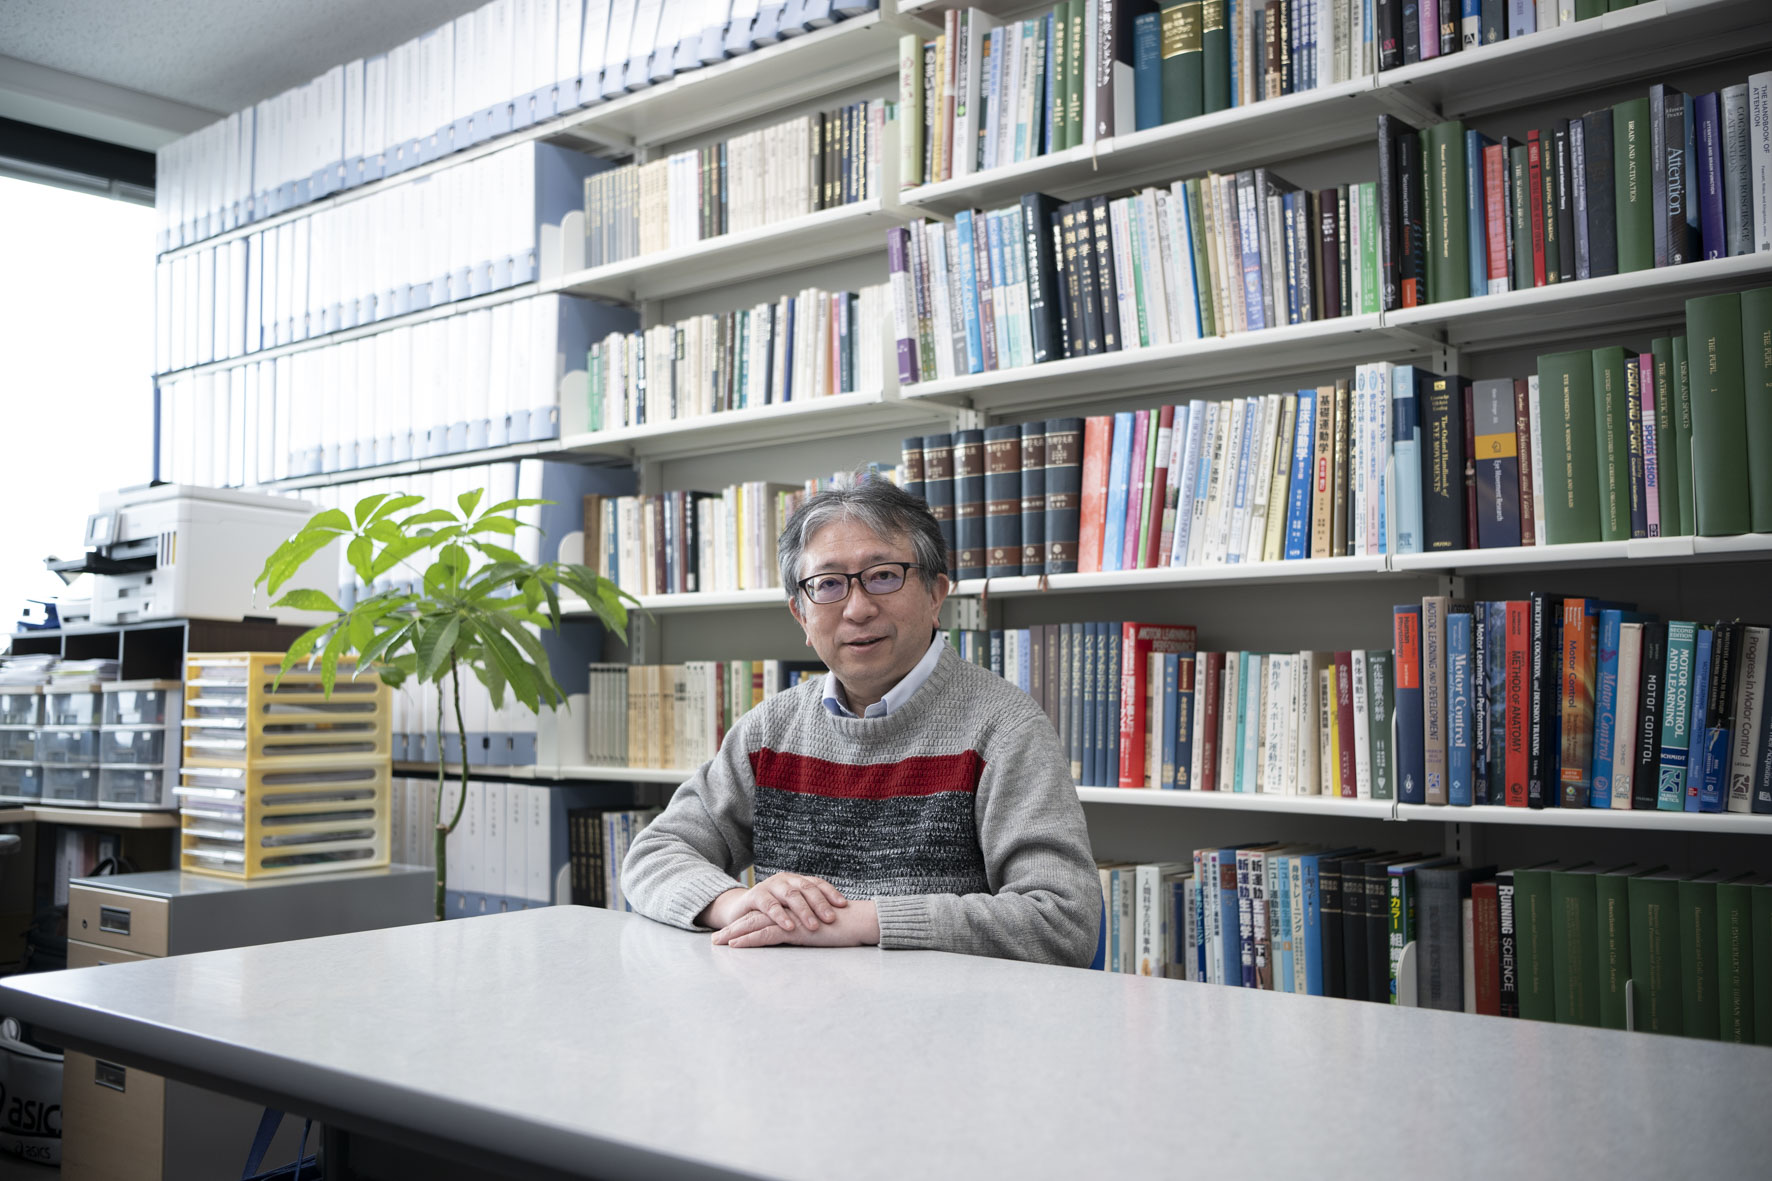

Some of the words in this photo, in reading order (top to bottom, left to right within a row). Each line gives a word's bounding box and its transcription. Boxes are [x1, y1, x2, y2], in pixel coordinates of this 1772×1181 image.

[1753, 87, 1761, 127] ATTENTION
[1761, 101, 1769, 142] HANDBOOK
[1728, 119, 1738, 174] ATTENTION
[1737, 107, 1747, 160] COGNITIVE
[1763, 144, 1770, 153] OF
[1668, 147, 1684, 216] Attention
[1740, 166, 1750, 241] NEUROSCIENCE
[1708, 337, 1716, 353] THE
[1763, 330, 1771, 346] THE
[1626, 362, 1639, 393] VISION
[1680, 361, 1688, 383] VISION
[1709, 354, 1717, 375] PUPIL
[1628, 394, 1640, 420] AND
[1660, 379, 1668, 412] ATHLETIC
[1681, 386, 1689, 400] AND
[1318, 395, 1330, 454] 基礎運動学
[1433, 422, 1441, 438] EYE
[1441, 416, 1449, 429] The
[1517, 417, 1527, 430] Eye
[1629, 421, 1642, 457] SPORT
[1645, 425, 1657, 455] SPORTS
[1441, 430, 1449, 452] Oxford
[1520, 433, 1529, 473] Movements
[1433, 440, 1441, 492] MOVEMENTS
[1493, 460, 1501, 469] Eye
[1647, 457, 1655, 487] VISION
[1441, 489, 1449, 498] of
[1495, 470, 1503, 498] Movement
[1522, 476, 1530, 491] and
[1428, 602, 1437, 629] MOTOR
[1428, 631, 1437, 669] LEARNING
[1476, 624, 1485, 649] Motor
[1454, 654, 1467, 692] Motor
[1476, 650, 1484, 685] Learning
[1511, 650, 1521, 692] METHOD
[1533, 641, 1541, 680] COGNITION,
[1569, 640, 1577, 670] Motor
[1669, 648, 1678, 671] AND
[1677, 649, 1690, 687] MOTOR
[1746, 637, 1759, 678] Progress
[1271, 660, 1281, 691] 動作学
[1354, 657, 1364, 714] 身体運動工学
[1568, 673, 1576, 708] Control
[1602, 672, 1615, 707] Motor
[1429, 686, 1438, 741] DEVELOPMENT
[1512, 694, 1520, 704] OF
[1533, 692, 1541, 723] DECISION
[1665, 673, 1678, 727] LEARNING
[1674, 688, 1688, 738] CONTROL
[1743, 692, 1754, 720] Motor
[1268, 702, 1280, 772] スポーツ運動学
[1455, 696, 1467, 747] Control
[1477, 698, 1485, 749] Performance
[1512, 706, 1521, 753] ANATOMY
[1599, 712, 1613, 761] Control
[1532, 724, 1540, 756] TRAINING
[1740, 723, 1751, 757] Control
[1763, 749, 1772, 786] Acquisition
[1238, 859, 1252, 940] 新運動生理学
[1251, 860, 1266, 941] 新運動生理学
[1269, 862, 1281, 938] ニュー運動生理学
[1292, 865, 1302, 933] 身体トレーニング
[1498, 885, 1514, 934] RUNNING
[1502, 937, 1514, 992] SCIENCE
[8, 1097, 63, 1136] asic
